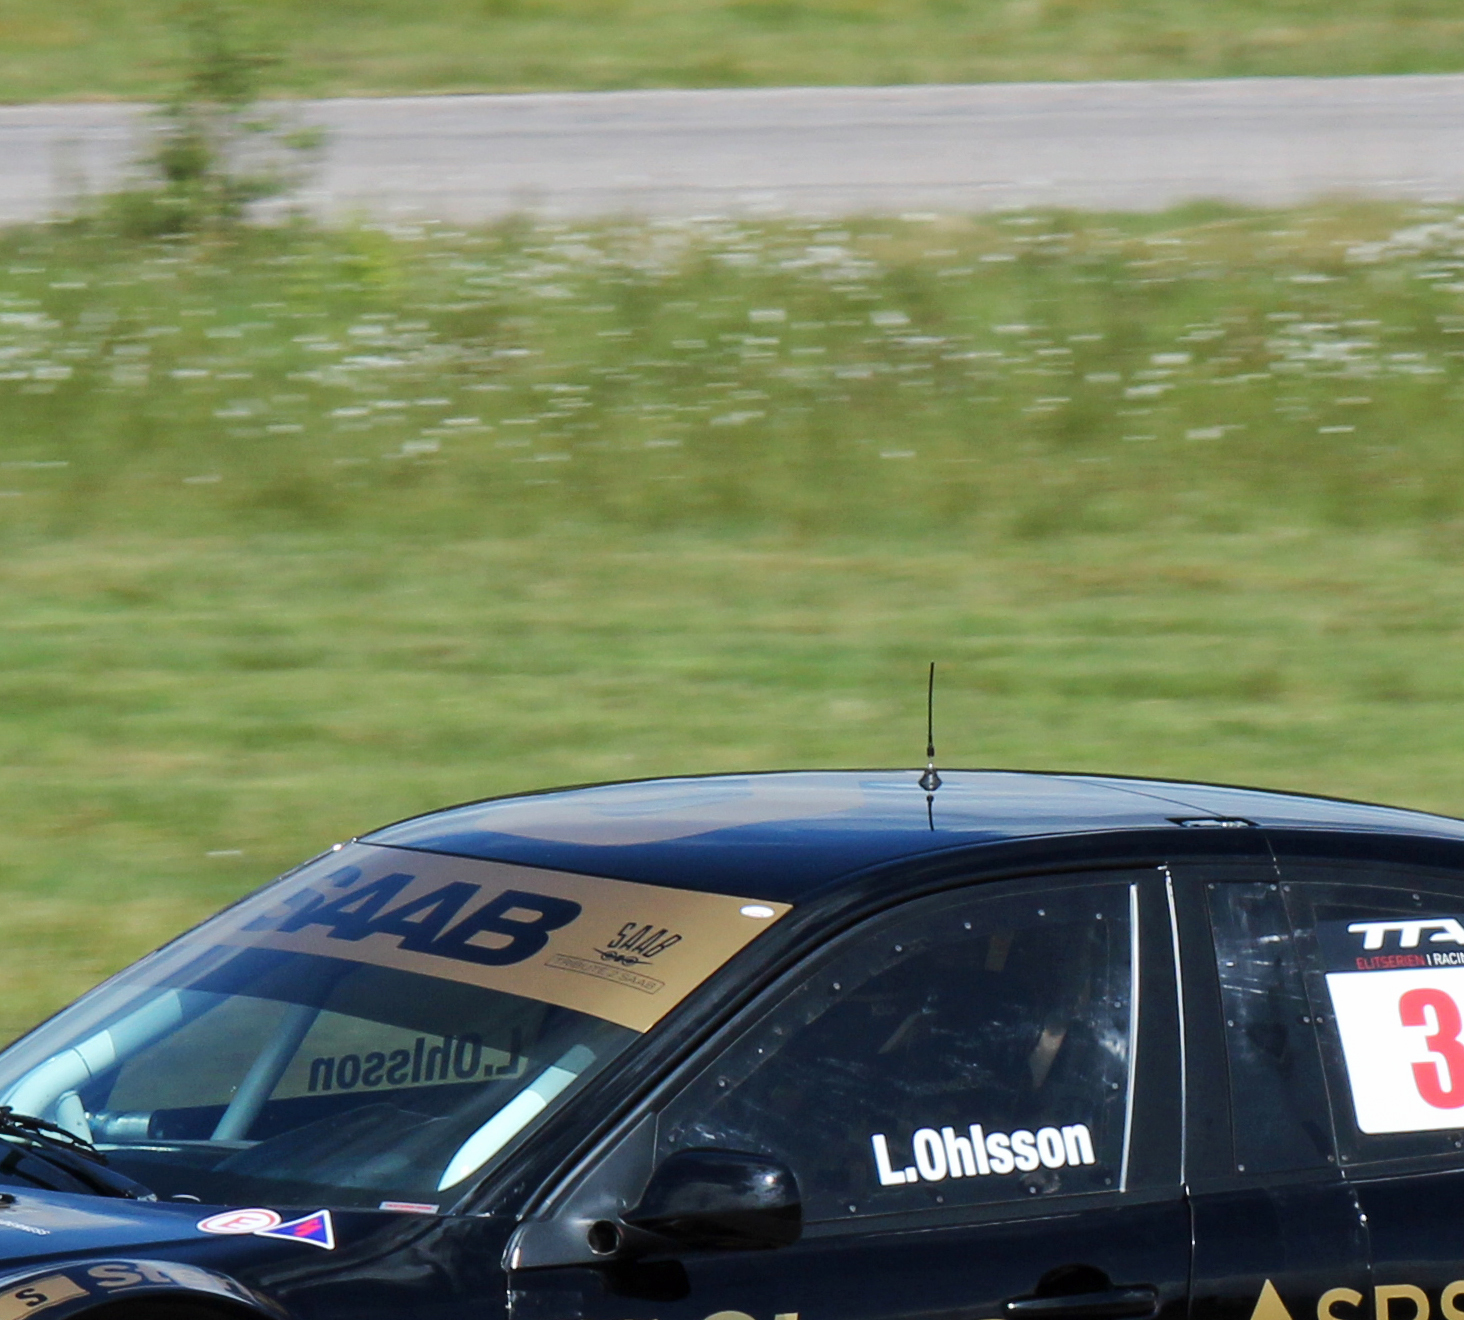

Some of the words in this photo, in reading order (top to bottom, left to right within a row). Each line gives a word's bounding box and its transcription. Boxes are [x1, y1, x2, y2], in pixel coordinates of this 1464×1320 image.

[240, 865, 582, 967] SAAB
[607, 922, 682, 958] SAAB
[1356, 954, 1425, 970] ELITSERIEN
[871, 1123, 1096, 1187] L.Ohlsson
